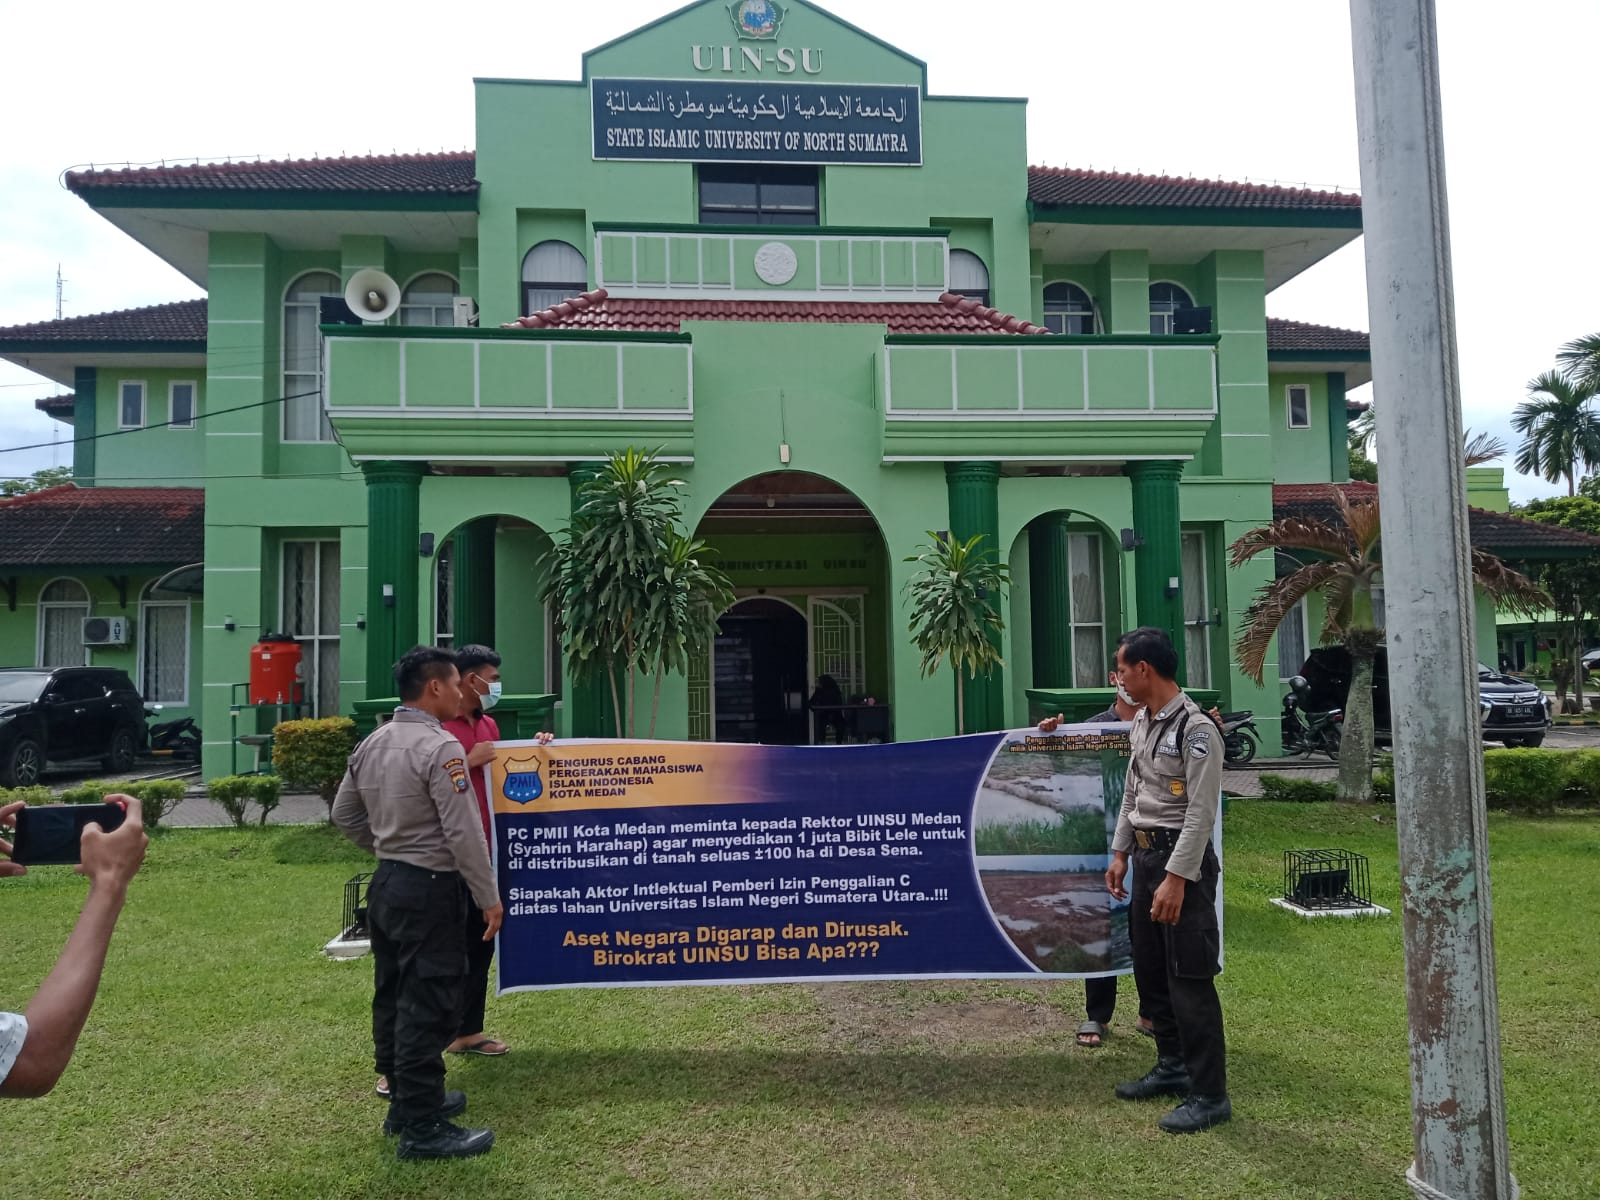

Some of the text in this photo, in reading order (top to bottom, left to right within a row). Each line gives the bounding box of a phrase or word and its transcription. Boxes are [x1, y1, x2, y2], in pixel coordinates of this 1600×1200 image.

[692, 45, 825, 74] UIN-SU
[855, 96, 907, 123] الجامعة
[607, 128, 909, 153] STATE ISLAMIC UNIVERSITY OF NORTH SUMATRA
[1028, 743, 1065, 752] Universitas
[1066, 743, 1085, 751] Islam
[1086, 742, 1108, 751] Negeri
[1109, 741, 1131, 750] Sumat
[1063, 734, 1082, 743] tanah
[1084, 733, 1100, 742] atau
[1100, 733, 1120, 743] galian
[549, 755, 666, 769] PENGURUS CABANG
[549, 764, 704, 778] PERGERAKAN MAHASISWA
[510, 776, 537, 788] PMII
[549, 776, 654, 789] ISLAM INDONESIA
[549, 787, 626, 799] KOTA MEDAN
[508, 812, 962, 840] PC PMII Kota Medan meminta kepada Rektor UINSU Medan
[508, 827, 966, 858] (Syahrin Harahap) agar menyediakan 1 juta Bibit Lele untuk
[508, 843, 923, 870] di distribusikan di tanah seluas ±100 ha di Desa Sena.
[509, 874, 911, 902] Siapakah Aktor Intlektual Pemberi Izin Penggalian C
[509, 888, 949, 916] diatas lahan Universitas Islam Negeri Sumatera Utara..!!!
[563, 920, 910, 948] Aset Negara Digarap dan Dirusak.
[593, 941, 880, 966] Birokrat UINSU Bisa Apa???
